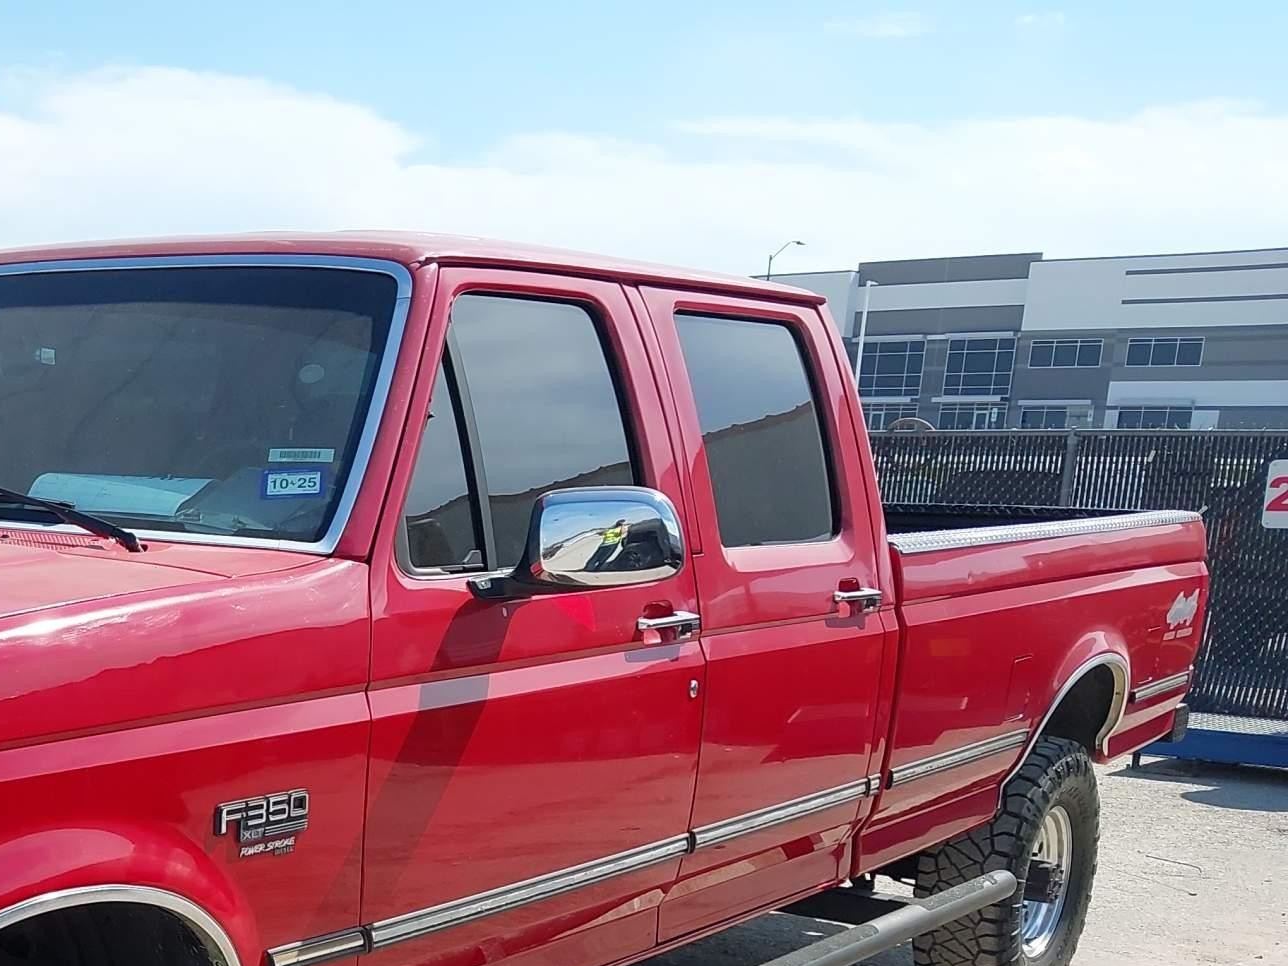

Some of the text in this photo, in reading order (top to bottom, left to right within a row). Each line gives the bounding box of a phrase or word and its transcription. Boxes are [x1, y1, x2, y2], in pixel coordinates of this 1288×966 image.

[242, 828, 265, 841] XLT
[240, 837, 296, 858] POWER STROKE
